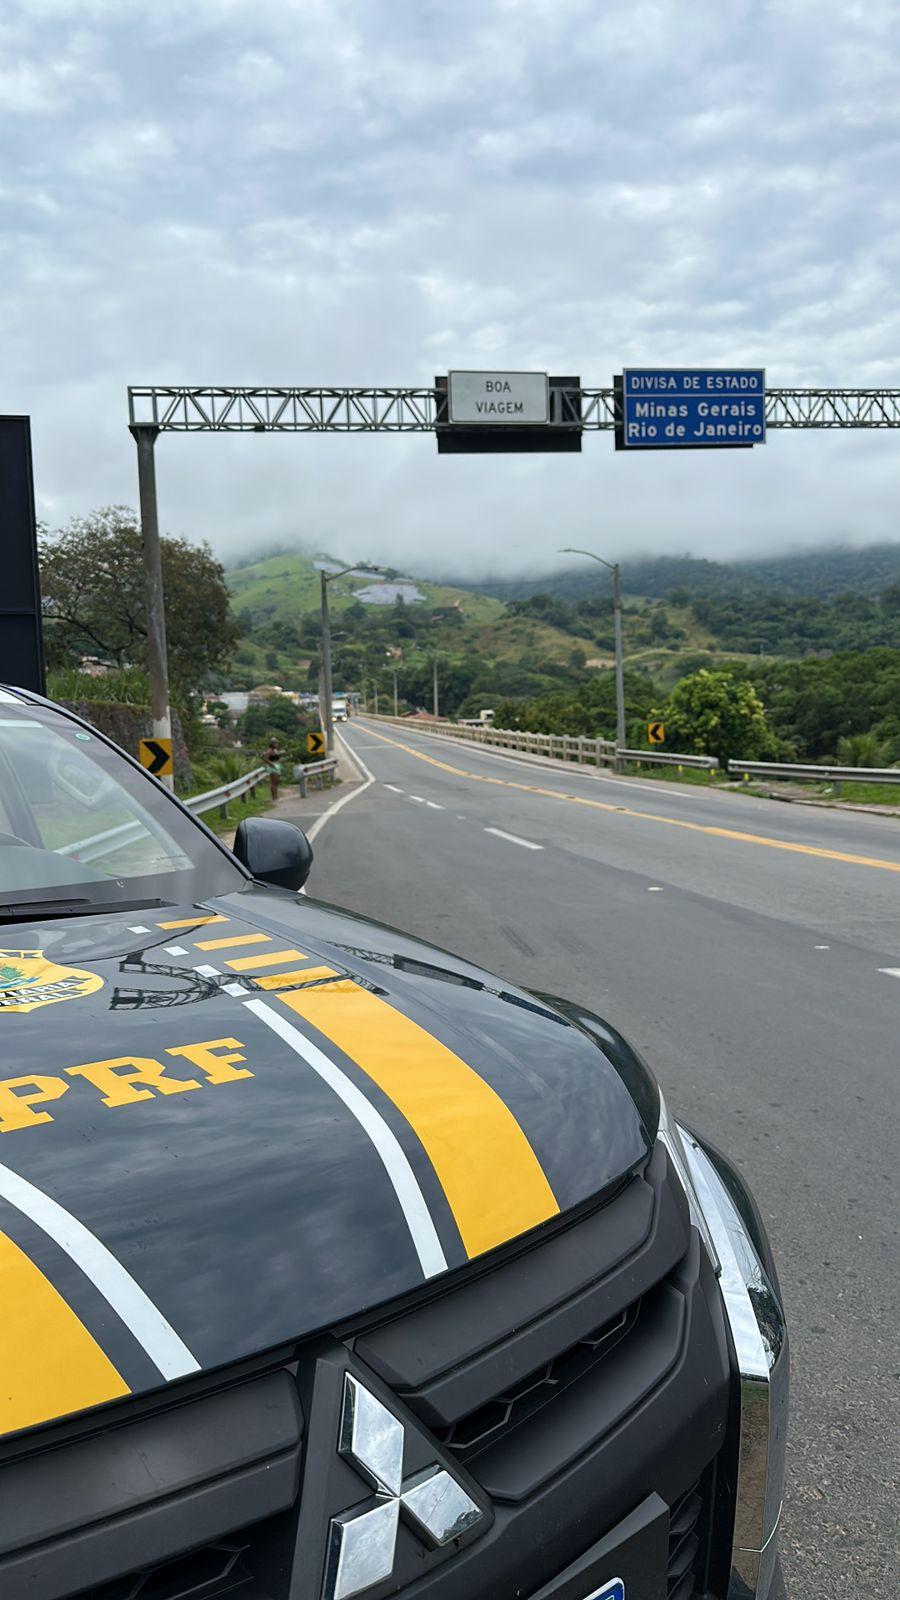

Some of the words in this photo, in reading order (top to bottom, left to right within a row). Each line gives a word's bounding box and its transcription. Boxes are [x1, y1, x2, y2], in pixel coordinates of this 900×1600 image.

[485, 380, 512, 393] BOA
[631, 376, 677, 389] DIVISA
[683, 376, 701, 389] DE
[706, 376, 758, 389] ESTADO
[475, 401, 524, 414] VIAGEM
[635, 401, 688, 417] Minas
[697, 401, 756, 417] Gerais
[628, 421, 657, 437] Rio
[665, 421, 686, 437] de
[693, 420, 762, 437] Janeiro
[0, 1037, 255, 1133] PRF
